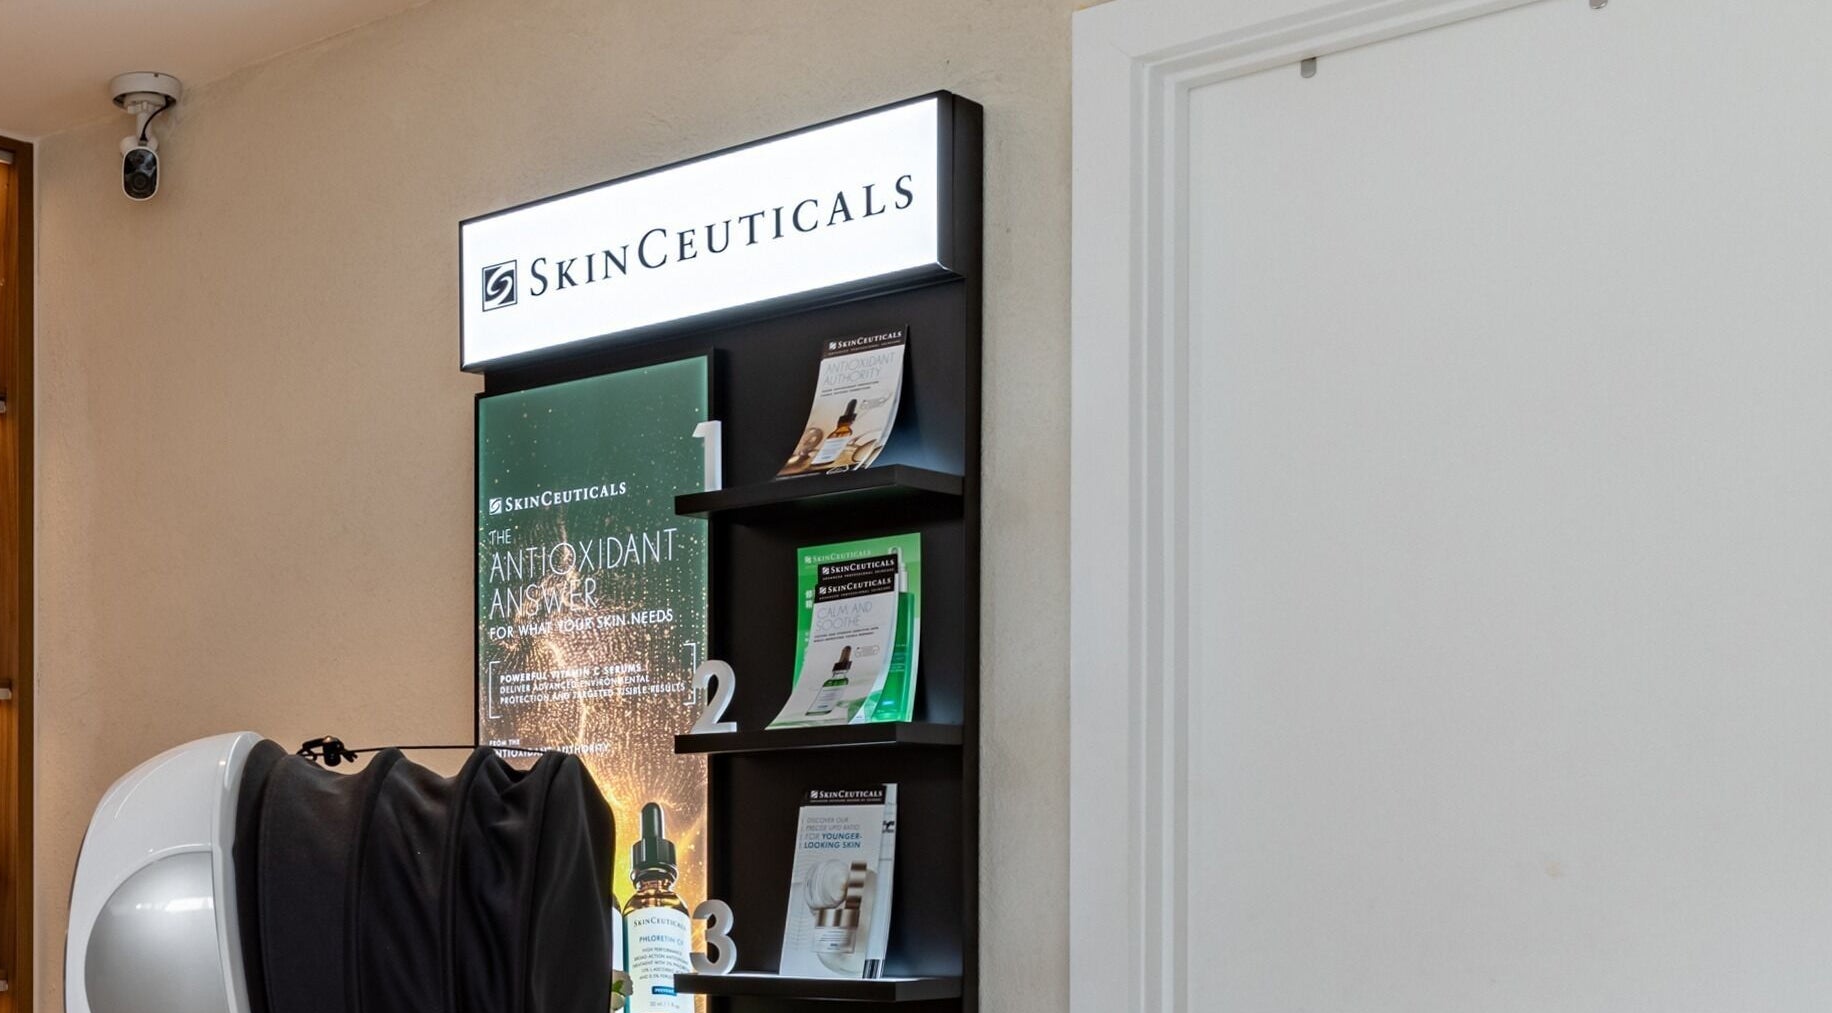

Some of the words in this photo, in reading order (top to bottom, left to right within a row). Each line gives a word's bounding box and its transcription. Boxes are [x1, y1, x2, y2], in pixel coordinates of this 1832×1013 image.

[529, 174, 915, 297] SKINCEUTICALS
[837, 331, 902, 349] SKINCEUTICALS
[825, 352, 895, 374] ANTIOXIDANT
[823, 367, 881, 386] AUTHORITY
[692, 420, 722, 491] 1
[505, 481, 627, 512] SKINCEUTICALS
[489, 528, 512, 546] THE
[489, 528, 678, 583] ANTIOXIDANT
[830, 559, 895, 575] SKINCEUTICALS
[828, 577, 892, 594] SKINCEUTICALS
[490, 577, 598, 620] ANSWER
[817, 604, 850, 620] CALM
[851, 601, 873, 614] AND
[489, 626, 514, 640] FOR
[518, 622, 552, 637] WHAT
[557, 617, 596, 633] YOUR
[597, 614, 626, 629] SKIN
[631, 609, 674, 625] NEEDS
[815, 615, 861, 632] SOOTHE
[500, 671, 547, 684] POWERFUL
[551, 667, 591, 680] VITAMIN
[593, 667, 600, 676] C
[603, 663, 642, 676] SERUMS
[500, 683, 531, 695] DELIVER
[532, 680, 577, 692] ADVANCED
[578, 674, 650, 689] ENVIRONMENTAL
[500, 693, 549, 705] PROTECTION
[552, 691, 570, 701] AND
[572, 687, 614, 700] TARGETED
[617, 684, 647, 697] VISIBLE
[650, 681, 686, 694] RESULTS
[691, 660, 737, 735] 2
[508, 738, 520, 746] THE
[804, 841, 841, 849] LOOKING
[842, 841, 861, 849] SKIN
[821, 832, 863, 840] YOUNGER-
[689, 899, 737, 976] 3
